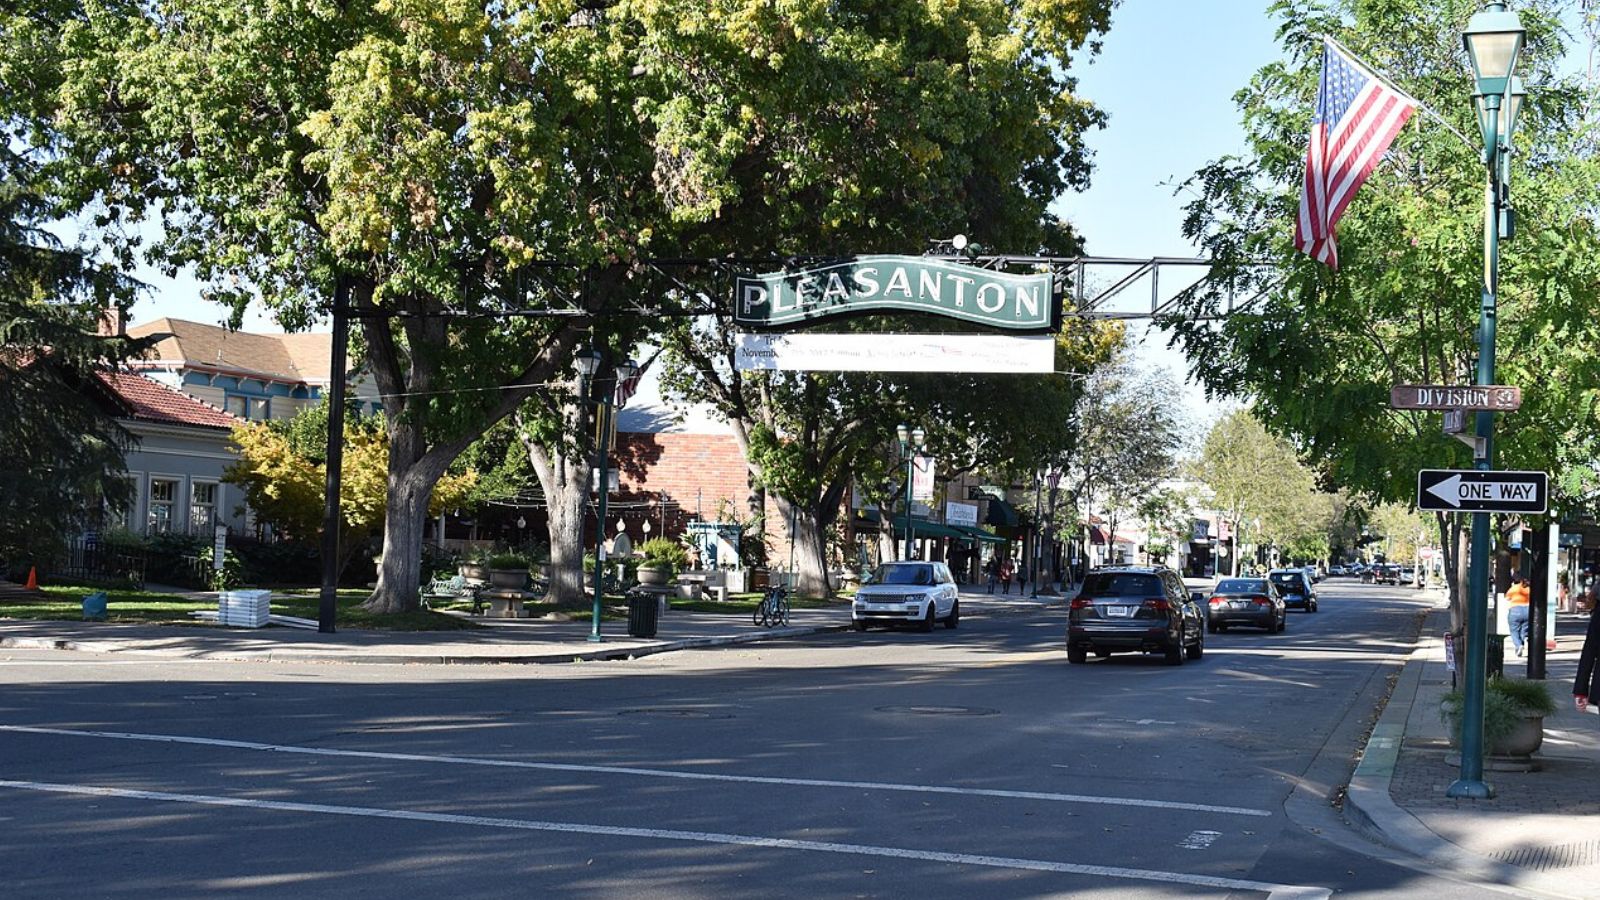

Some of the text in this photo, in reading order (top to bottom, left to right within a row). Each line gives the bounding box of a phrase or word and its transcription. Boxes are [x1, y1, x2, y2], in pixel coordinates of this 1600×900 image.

[744, 266, 1039, 317] PLEASANTON
[1416, 388, 1489, 407] DIVISION
[1458, 483, 1534, 499] ONE WAY
